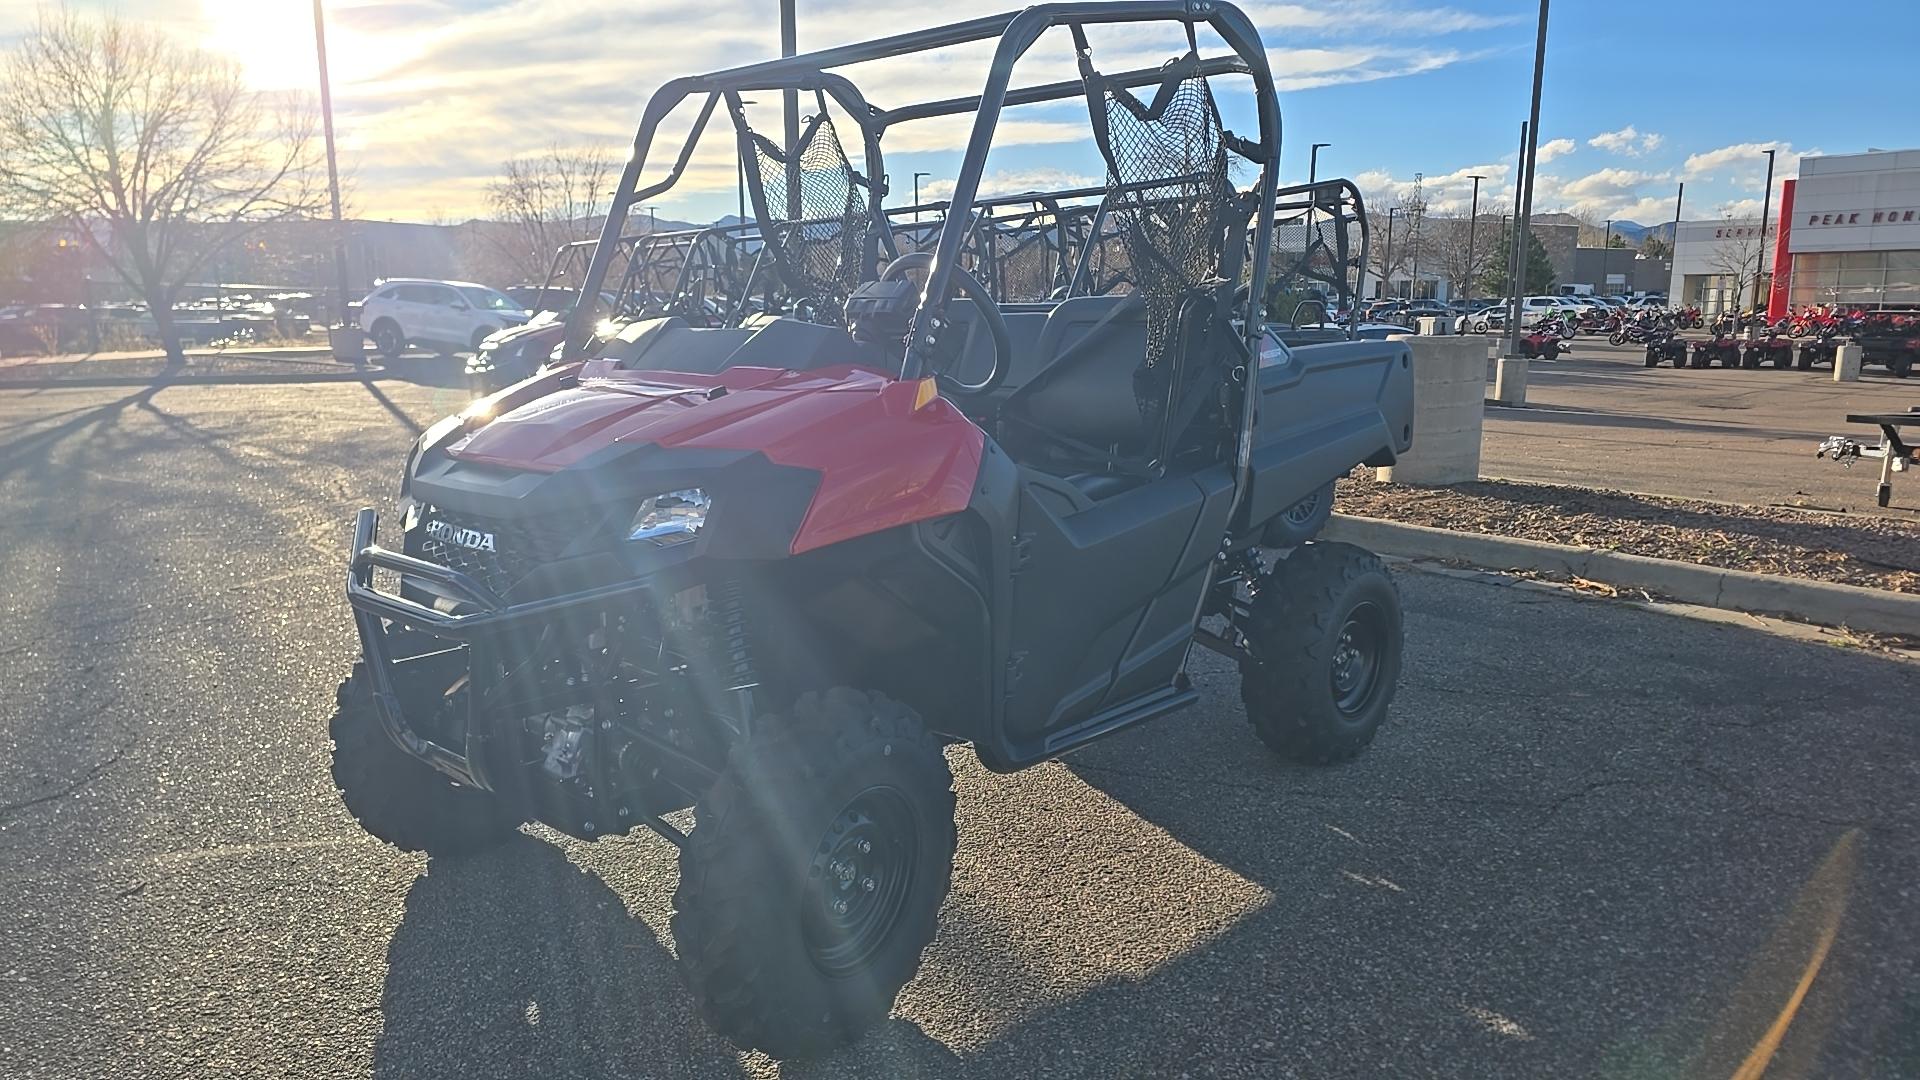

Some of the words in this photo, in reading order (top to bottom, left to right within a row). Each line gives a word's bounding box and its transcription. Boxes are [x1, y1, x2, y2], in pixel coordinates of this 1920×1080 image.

[1809, 213, 1860, 226] PEAK
[1872, 210, 1920, 224] HON
[429, 520, 496, 552] HONDA
